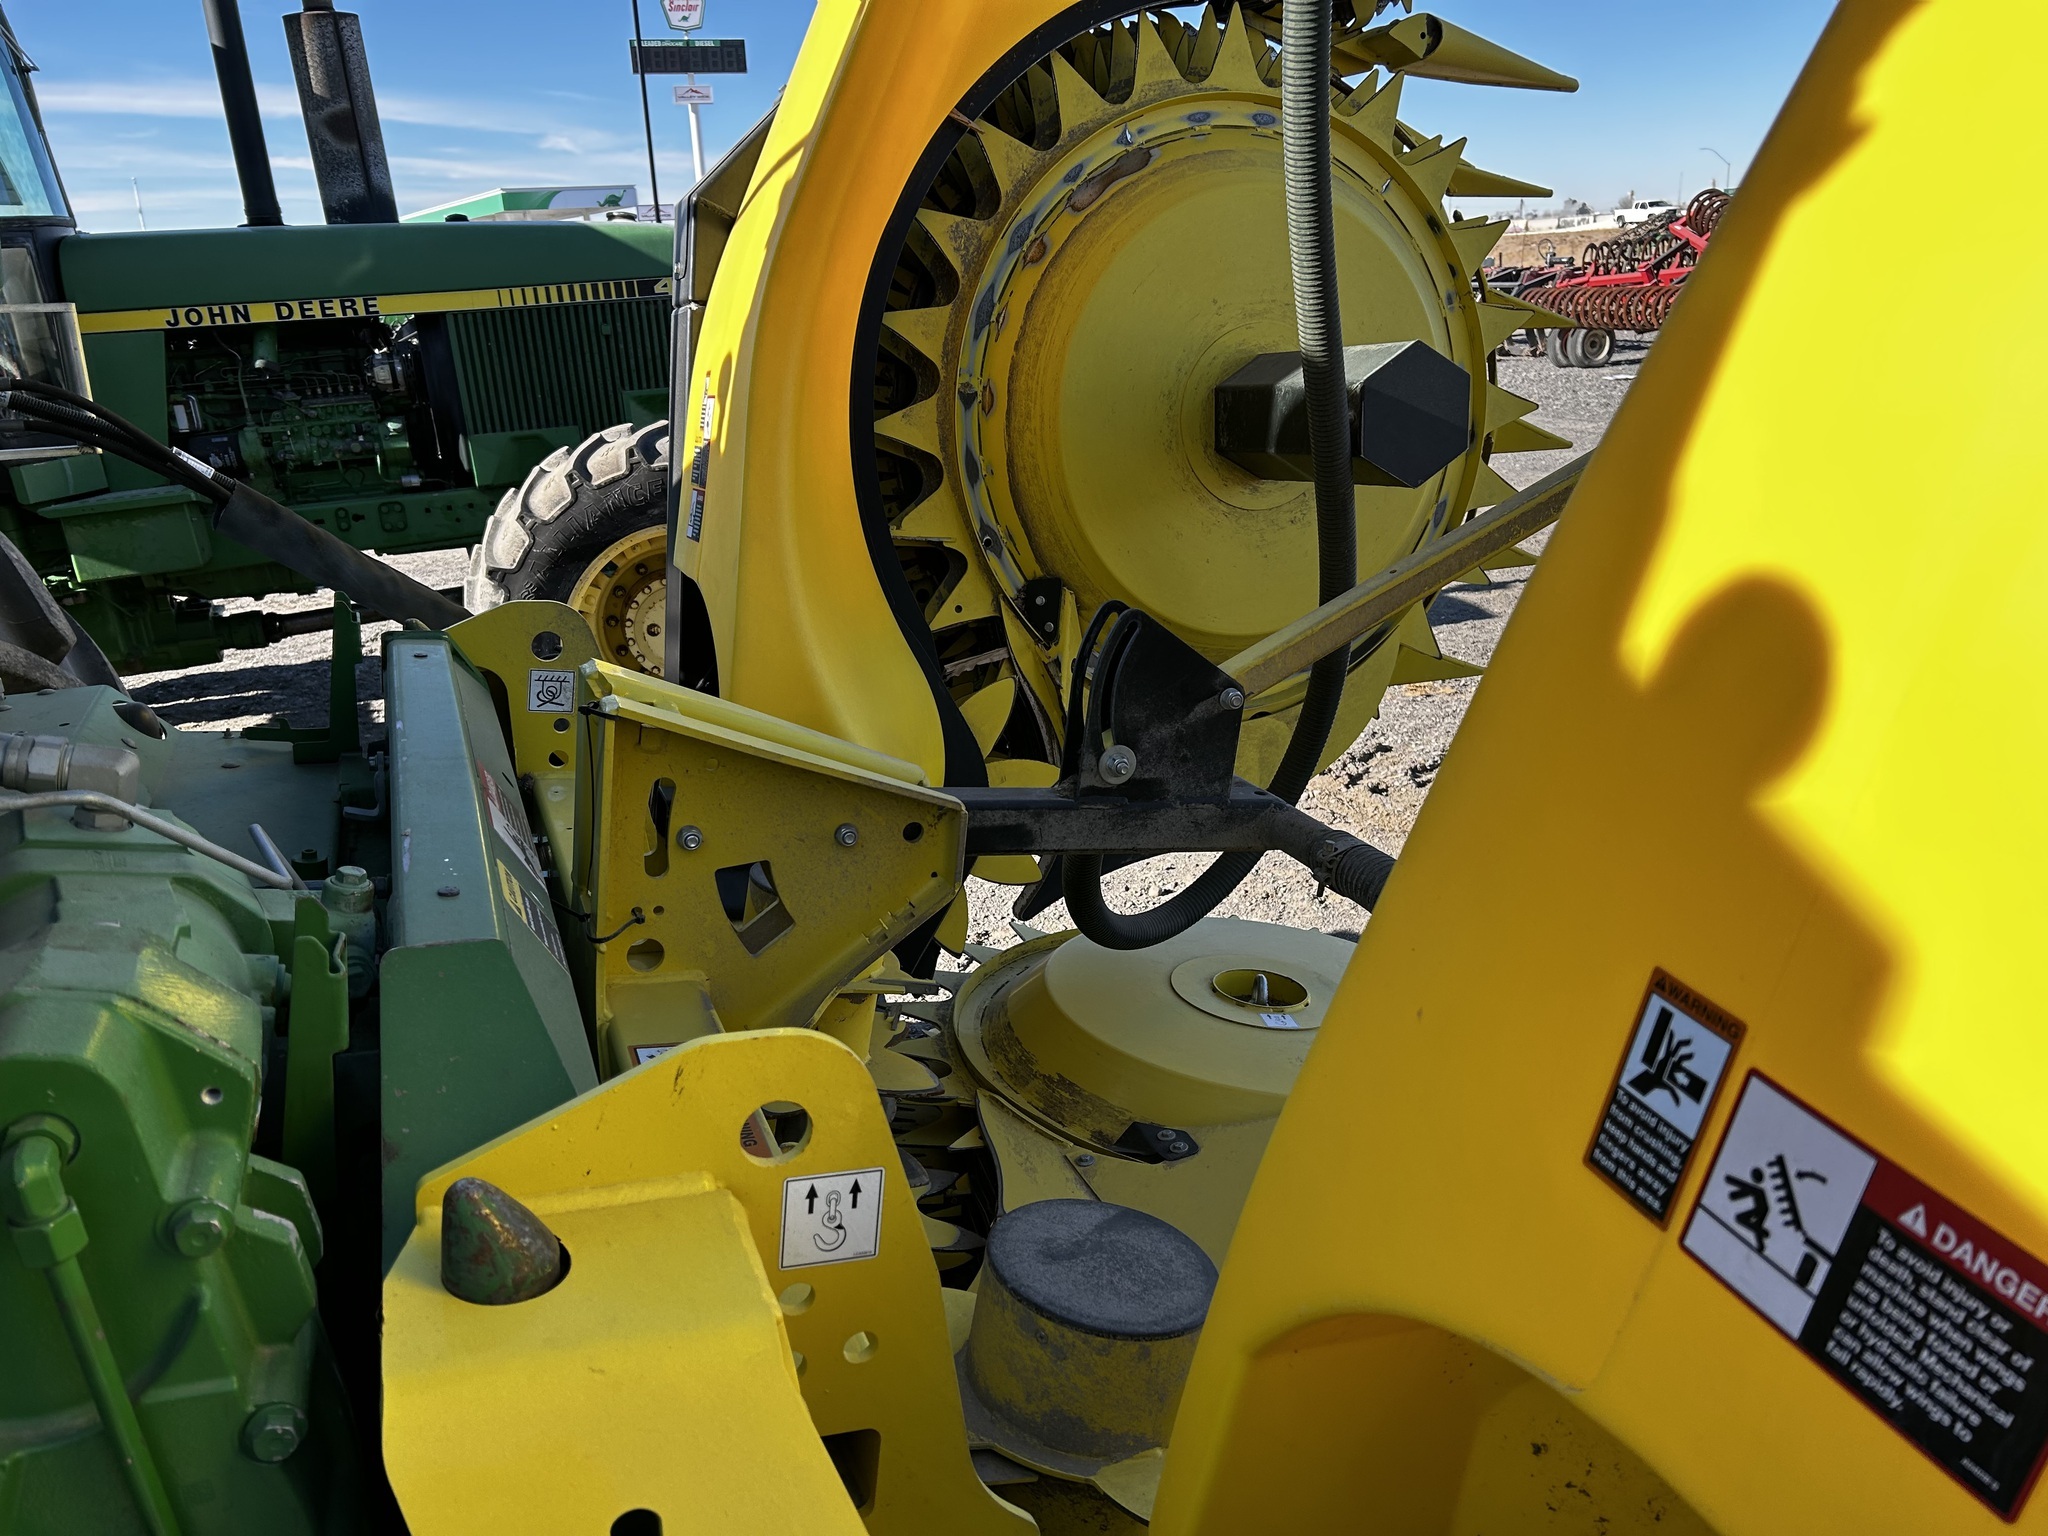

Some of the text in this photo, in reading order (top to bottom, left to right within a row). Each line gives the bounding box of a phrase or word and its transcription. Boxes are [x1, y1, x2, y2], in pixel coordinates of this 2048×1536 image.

[668, 0, 700, 12] Sinclair
[165, 296, 380, 328] JOHN DEERE
[528, 478, 665, 593] ALLIANCE
[1667, 981, 1741, 1040] WARNING
[1603, 1118, 1679, 1184] keep hands and
[1609, 1103, 1682, 1171] from crushing,
[1615, 1087, 1691, 1154] To avoid injury
[1592, 1147, 1663, 1214] from this area.
[1599, 1133, 1668, 1197] fingers away
[1867, 1247, 2035, 1373] death, stand clear of
[1877, 1226, 2014, 1334] To avoid injury or
[1846, 1293, 2016, 1430] unfolded. Mechanical
[1853, 1278, 2003, 1396] are being folded or
[1860, 1261, 2027, 1393] machine when wings
[1825, 1337, 1905, 1413] fall rapidly.
[1832, 1323, 1974, 1443] can allow wings to
[1839, 1310, 1982, 1428] or hydraulic failure
